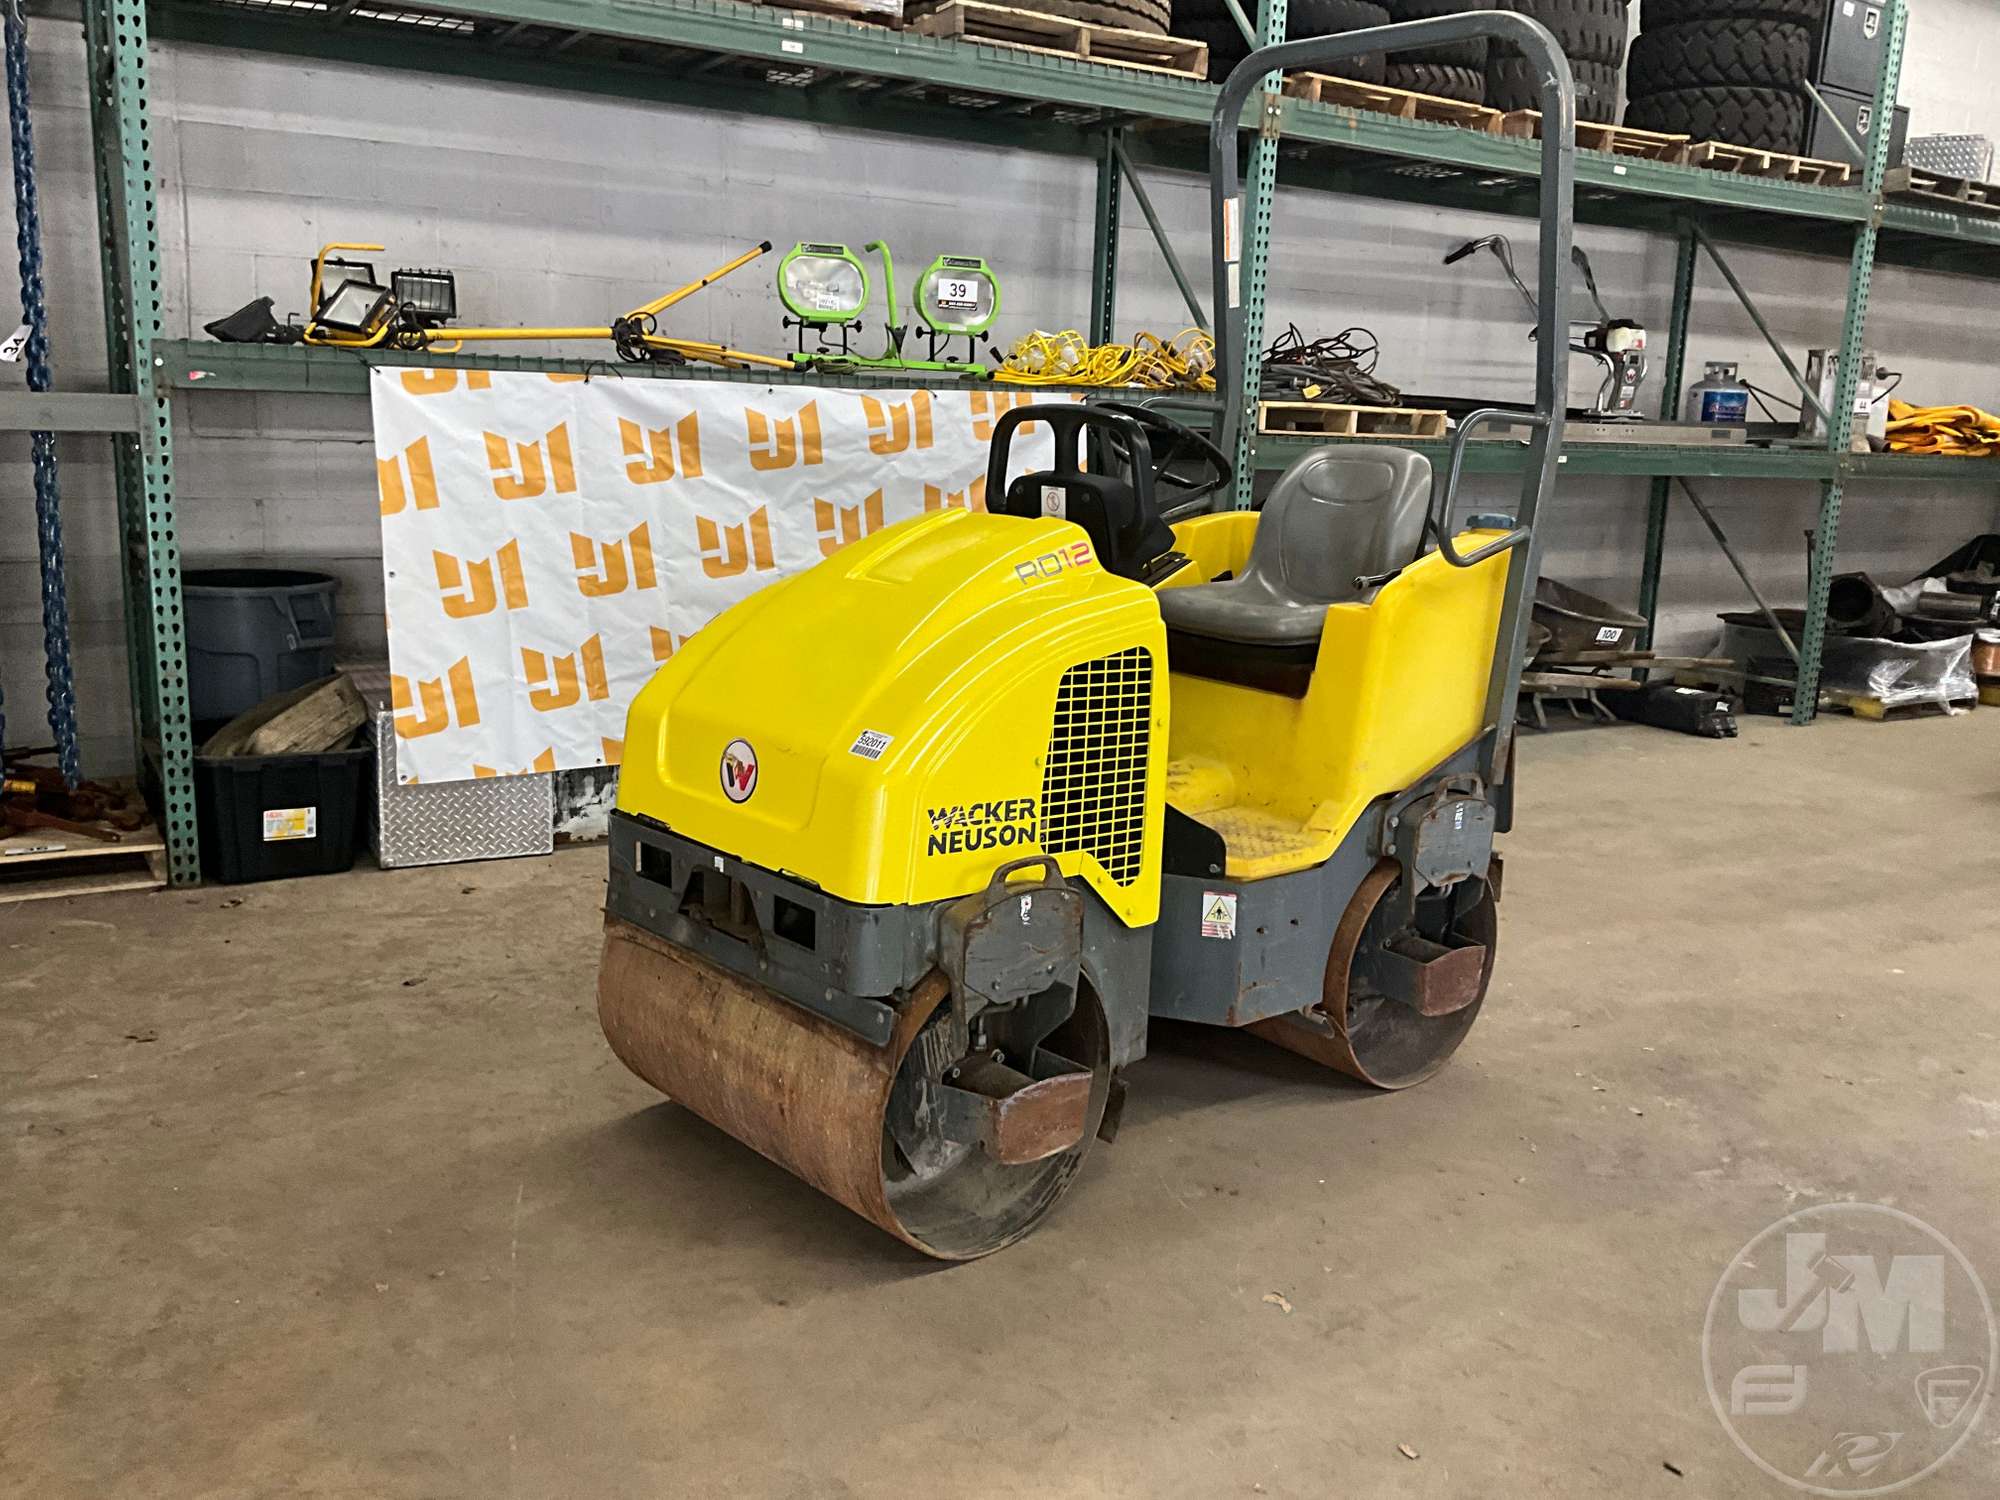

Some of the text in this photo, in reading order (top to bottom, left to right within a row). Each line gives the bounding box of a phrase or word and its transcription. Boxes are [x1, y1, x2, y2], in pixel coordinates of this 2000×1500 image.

[949, 282, 967, 298] 39
[1014, 542, 1093, 586] RD12
[1601, 629, 1618, 640] 100
[857, 735, 888, 750] 592011
[927, 798, 1037, 831] WACKER
[927, 821, 1037, 857] NEUSON
